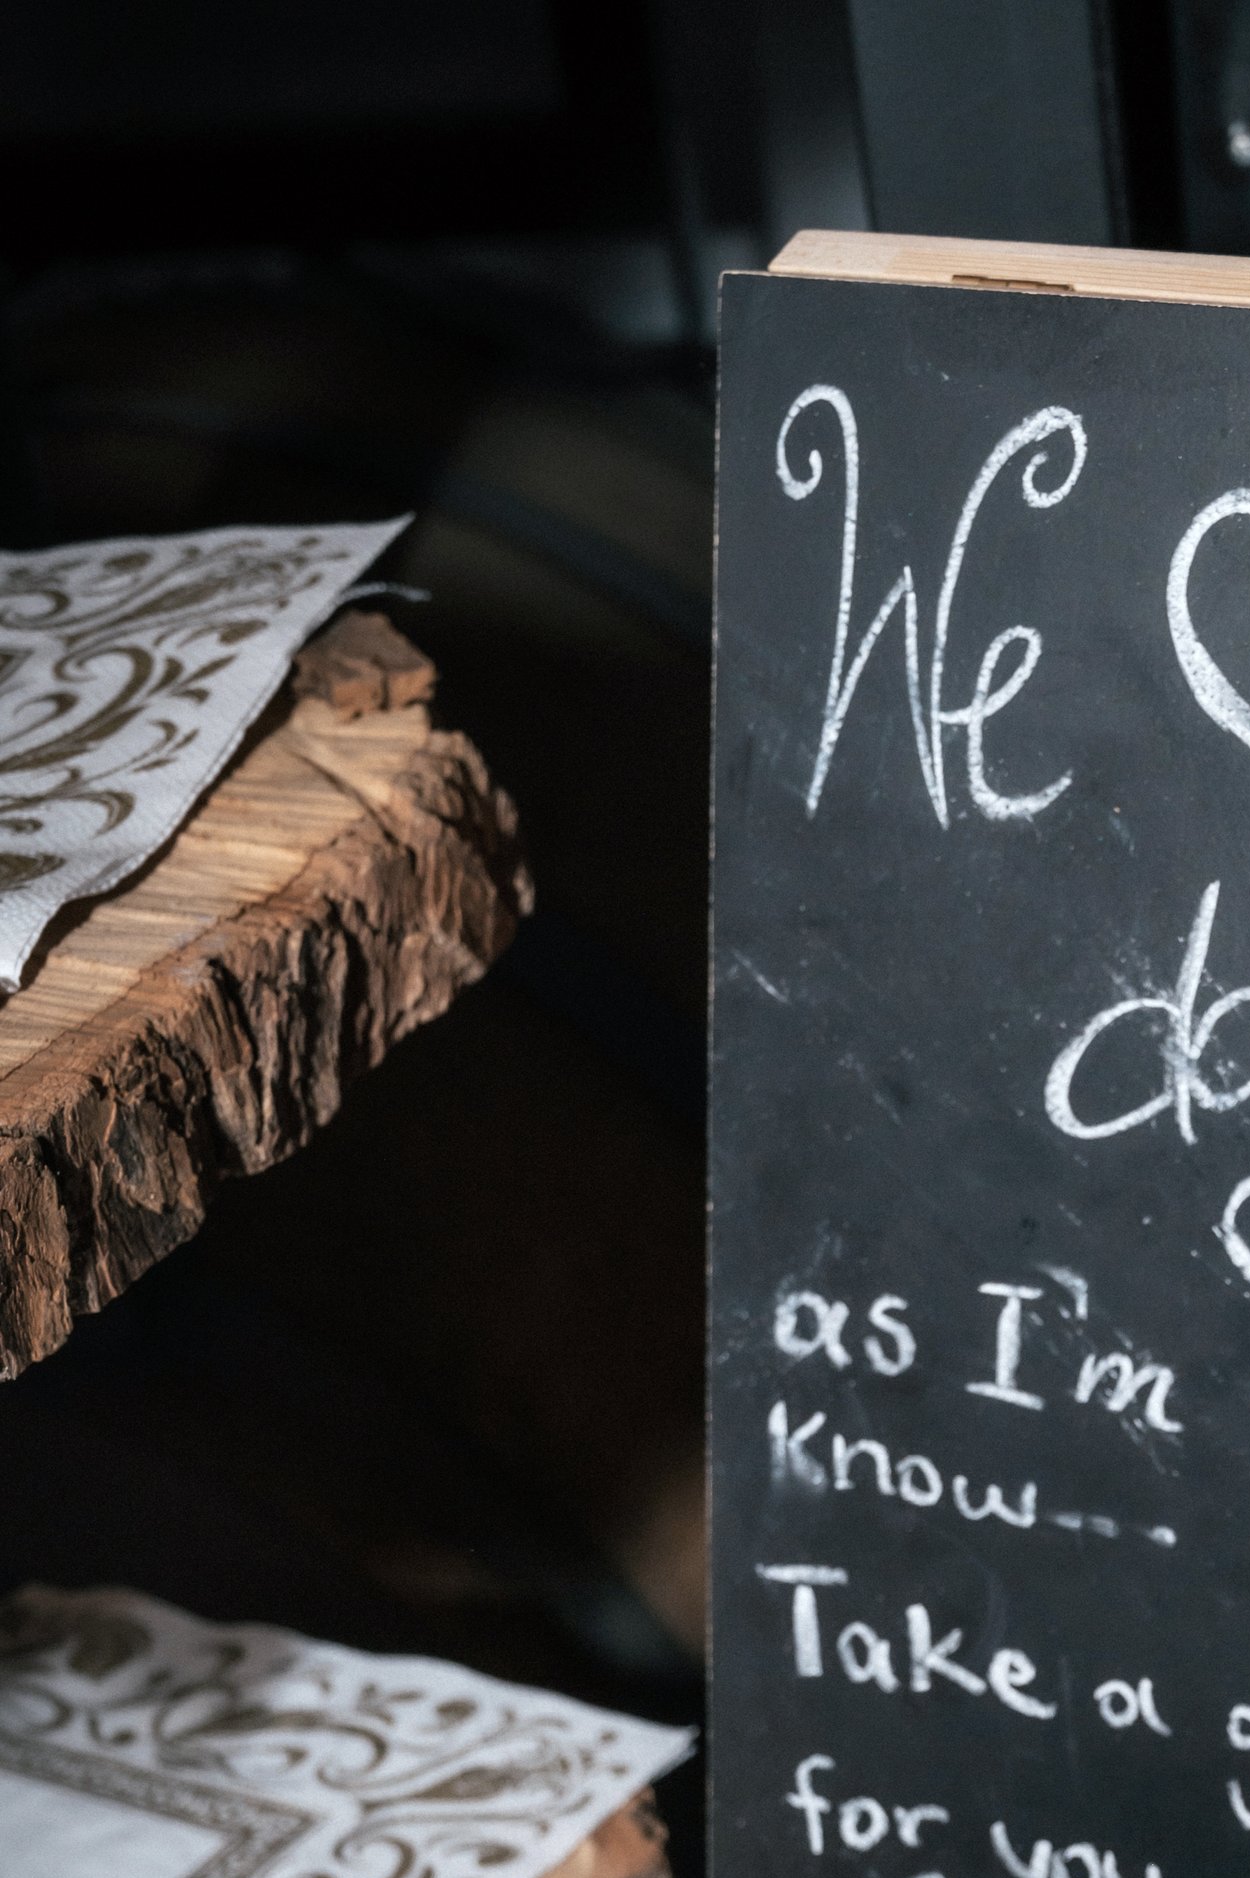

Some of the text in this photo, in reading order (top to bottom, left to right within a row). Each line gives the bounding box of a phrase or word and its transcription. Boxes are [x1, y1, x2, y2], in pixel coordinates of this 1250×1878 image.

[777, 384, 1086, 828] We
[774, 1290, 917, 1377] as
[965, 1264, 1184, 1433] I'm
[755, 1563, 1056, 1719] Take
[1094, 1676, 1170, 1736] a
[786, 1754, 948, 1855] for
